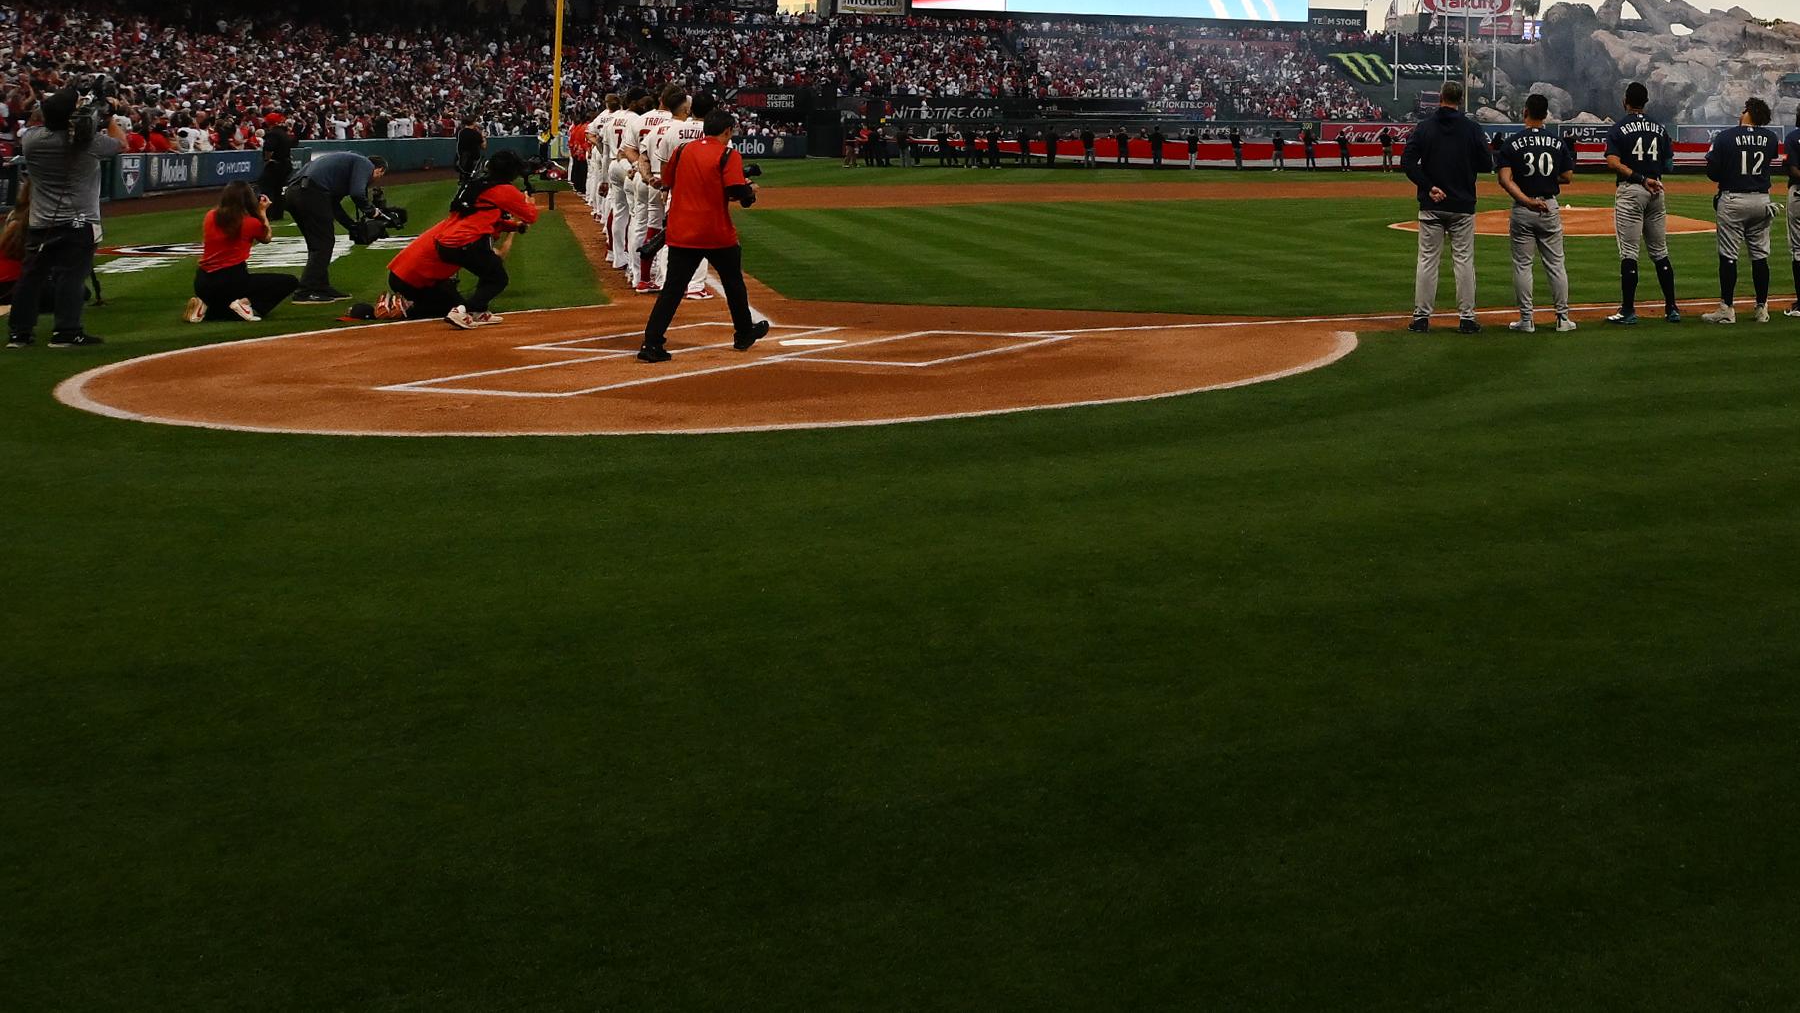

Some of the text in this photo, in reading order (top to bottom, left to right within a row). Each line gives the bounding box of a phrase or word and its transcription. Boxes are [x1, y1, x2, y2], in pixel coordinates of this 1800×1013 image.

[1336, 17, 1361, 27] STORE
[766, 93, 795, 101] SECURITY
[766, 100, 795, 108] SYSTEMS
[614, 129, 622, 149] 7
[1571, 127, 1596, 137] JUST
[732, 139, 766, 155] odelo
[1512, 136, 1562, 151] REFSNYDER
[1735, 135, 1768, 147] NAYLOR
[1632, 137, 1659, 161] 44
[121, 158, 141, 169] MLB
[226, 161, 251, 174] HYUNDAI
[1523, 152, 1554, 177] 30
[1741, 150, 1765, 175] 12
[160, 158, 188, 183] Modelo
